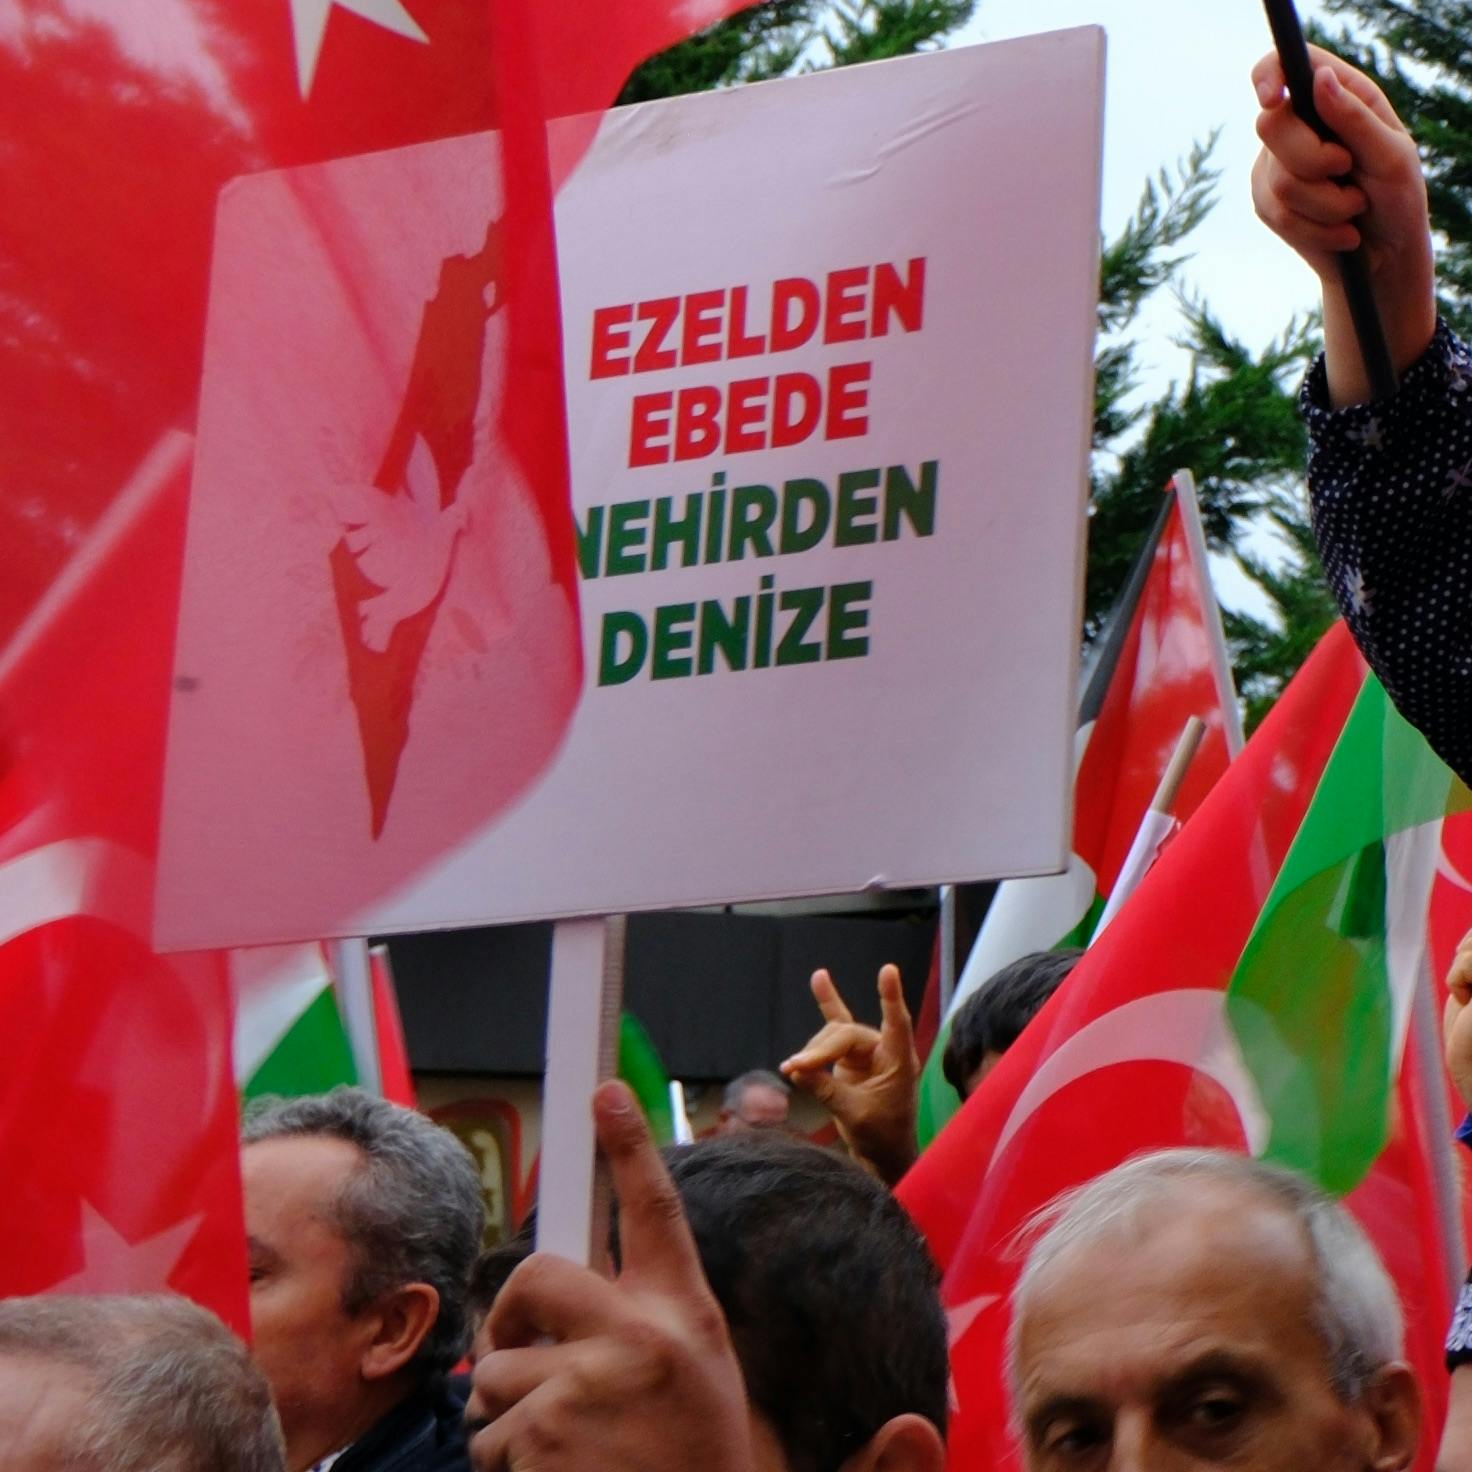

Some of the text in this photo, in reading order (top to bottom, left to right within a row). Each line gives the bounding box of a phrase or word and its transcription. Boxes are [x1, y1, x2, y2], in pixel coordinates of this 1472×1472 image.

[589, 256, 927, 381] EZELDEN
[627, 361, 872, 469] EBEDE
[596, 573, 874, 687] DENİZE
